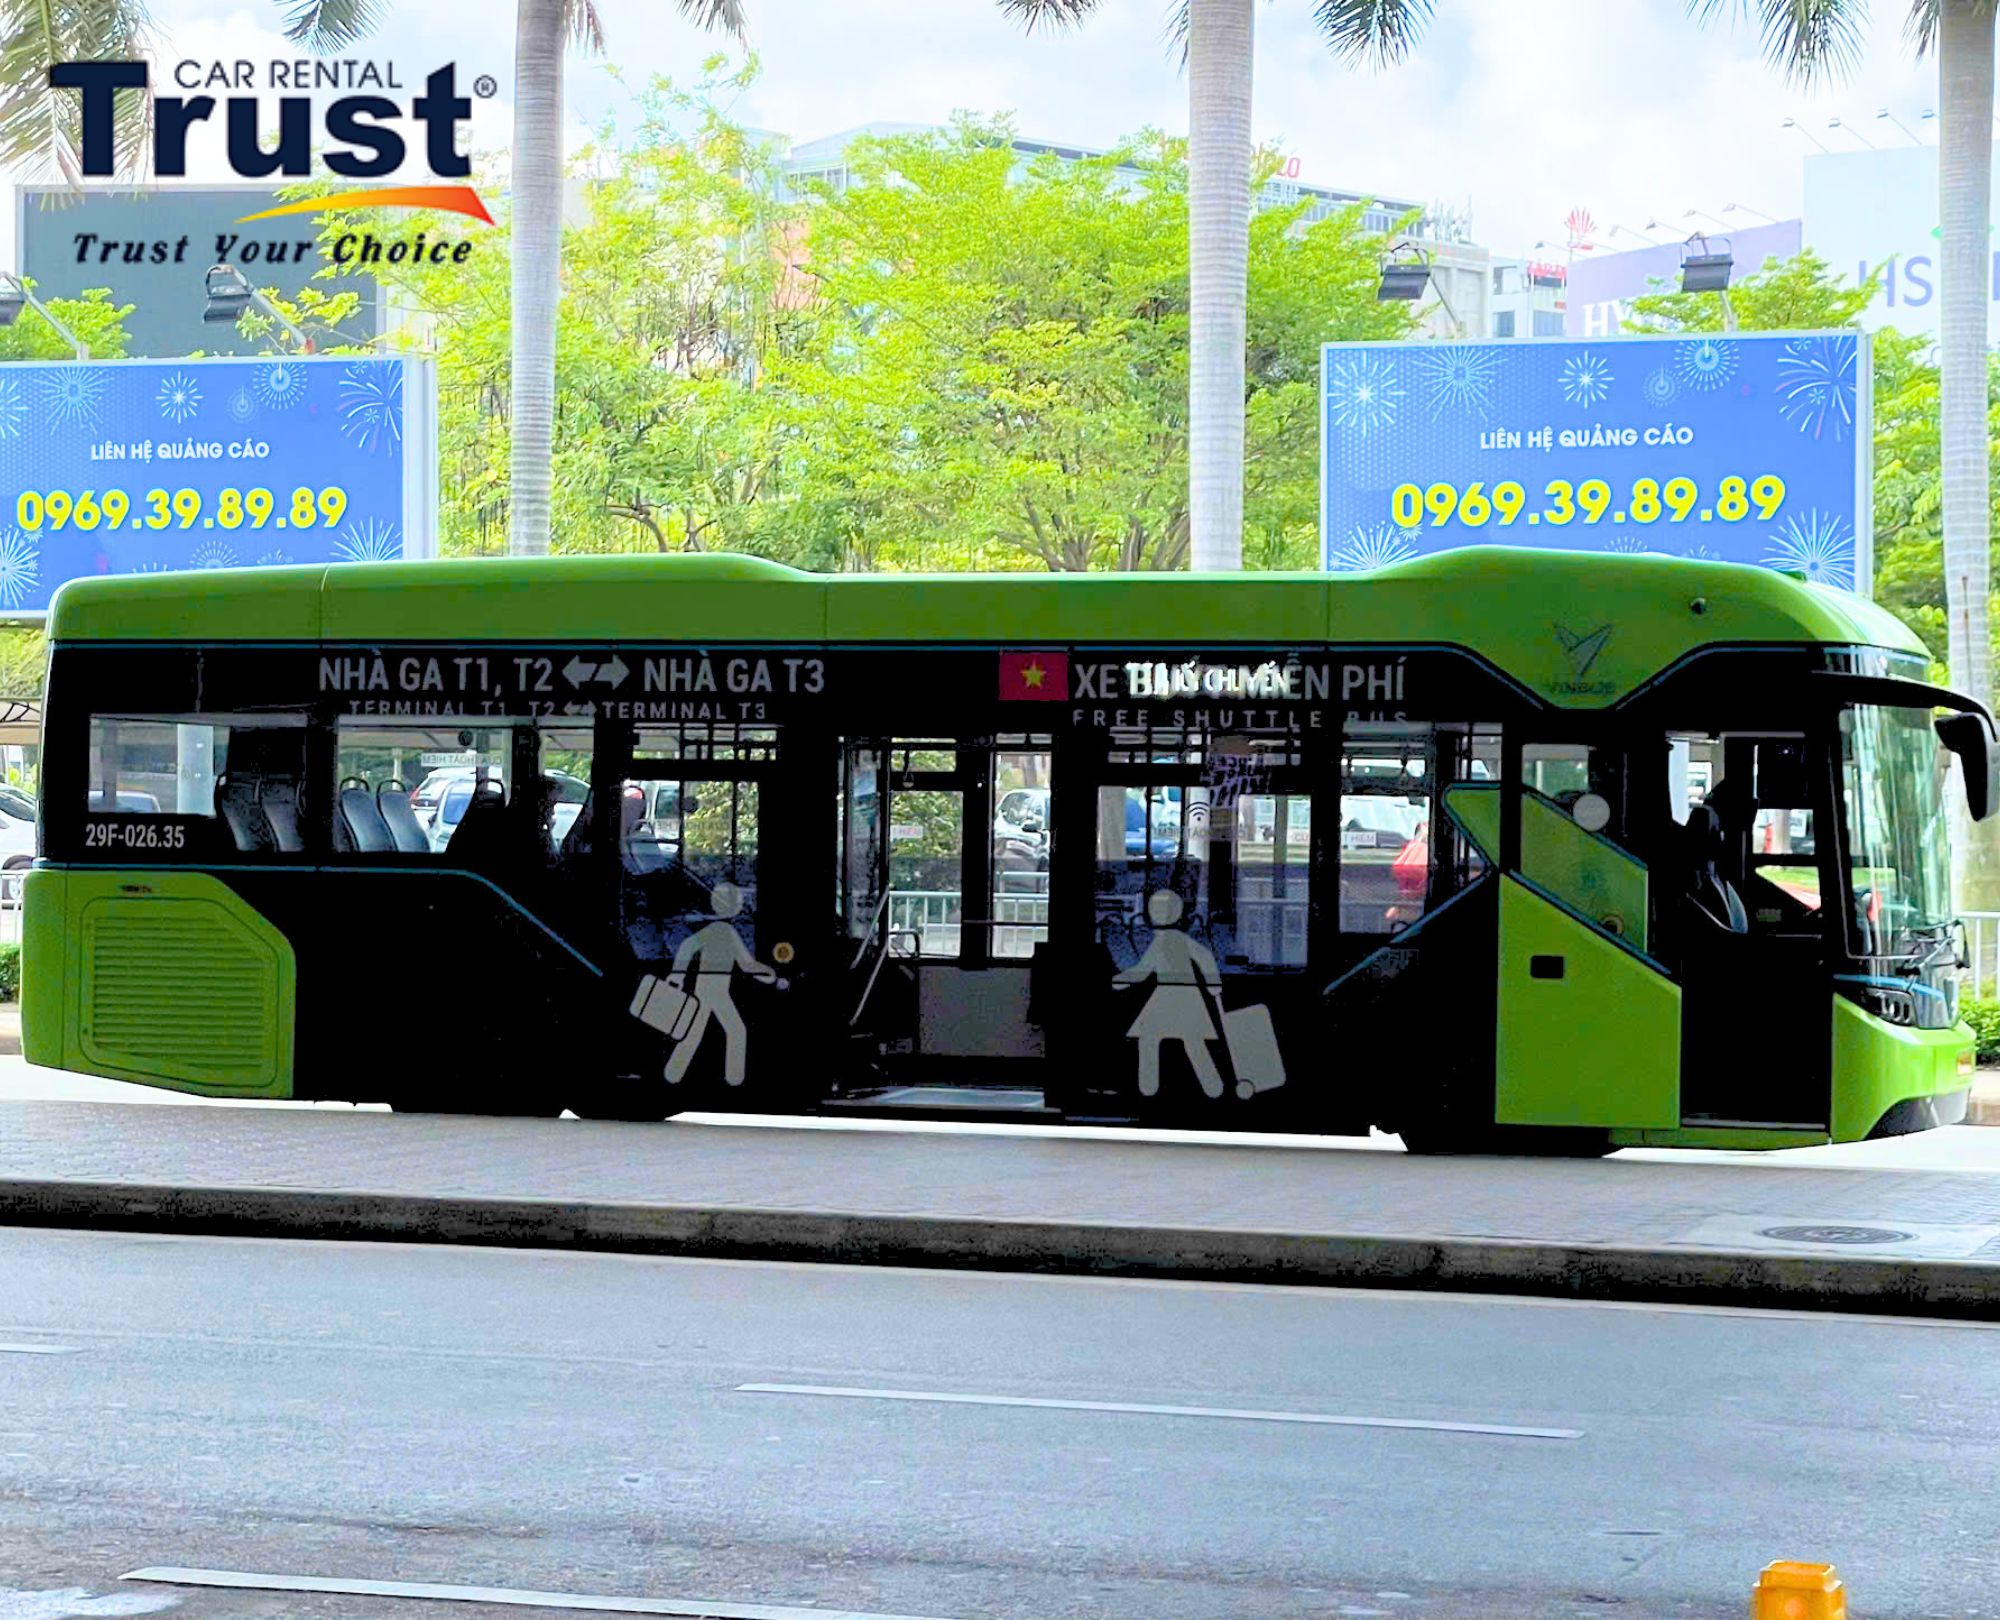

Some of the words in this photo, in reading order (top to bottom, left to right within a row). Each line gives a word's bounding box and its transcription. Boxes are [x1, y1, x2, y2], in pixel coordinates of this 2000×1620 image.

[90, 440, 127, 461] LIÊN
[131, 439, 153, 464] HỆ
[157, 438, 223, 460] QUẢNG
[228, 438, 270, 459] CÁO
[1480, 427, 1521, 450] LIÊN
[1527, 426, 1554, 453] HỆ
[1558, 423, 1638, 448] QUẢNG
[1644, 422, 1694, 446] CÁO
[16, 486, 348, 532] 0969.39.89.89
[1391, 474, 1786, 528] 0969.39.89.89
[319, 648, 390, 691] NHÀ
[399, 656, 444, 691] GA
[453, 657, 501, 698] T1,
[513, 657, 553, 692] T2
[643, 647, 718, 692] NHÀ
[726, 658, 773, 693] GA
[782, 658, 825, 693] T3
[1074, 663, 1119, 699] XE
[1342, 656, 1407, 701] PHÍ
[349, 700, 465, 716] TERMINAL
[528, 701, 556, 717] T2
[602, 701, 727, 719] TERMINAL
[738, 702, 766, 719] T3
[1072, 709, 1149, 727] FREE
[1172, 708, 1322, 728] SHUTTLE
[85, 823, 185, 848] 29F-026.35
